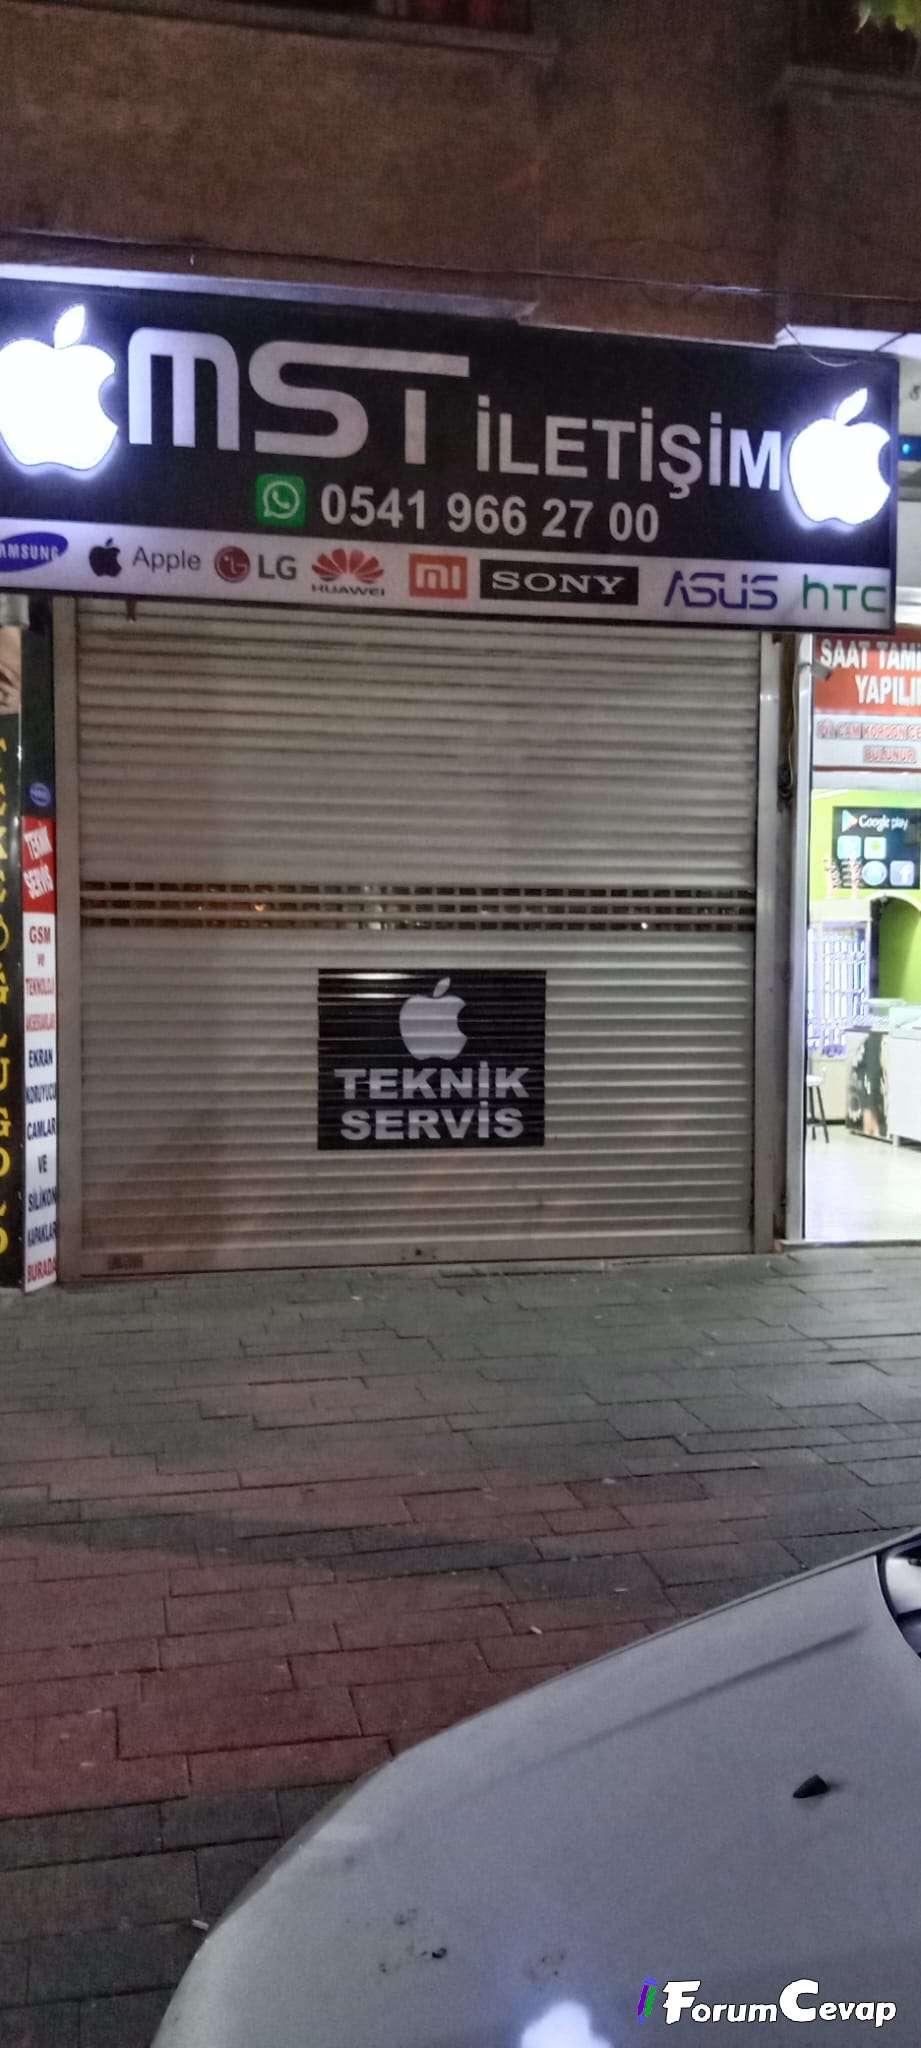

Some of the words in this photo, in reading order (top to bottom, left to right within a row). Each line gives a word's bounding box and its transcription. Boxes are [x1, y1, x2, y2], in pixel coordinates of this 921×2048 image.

[128, 327, 470, 465] MST
[476, 394, 782, 500] İLETİŞİM
[321, 483, 427, 530] 0541
[447, 491, 527, 537] 966
[542, 499, 595, 539] 27
[608, 502, 660, 544] 00
[133, 546, 201, 573] Apple
[258, 554, 297, 580] LG
[311, 583, 385, 597] HUAWEI
[491, 570, 626, 596] SONY
[664, 570, 779, 611] ASUS
[821, 638, 869, 670] SAAT
[29, 926, 51, 944] GSM
[29, 1048, 53, 1069] EKRAN
[334, 1060, 530, 1100] TEKNİK
[27, 1117, 56, 1140] CAMLAR
[340, 1100, 524, 1141] SERVİS
[37, 1154, 47, 1174] VE
